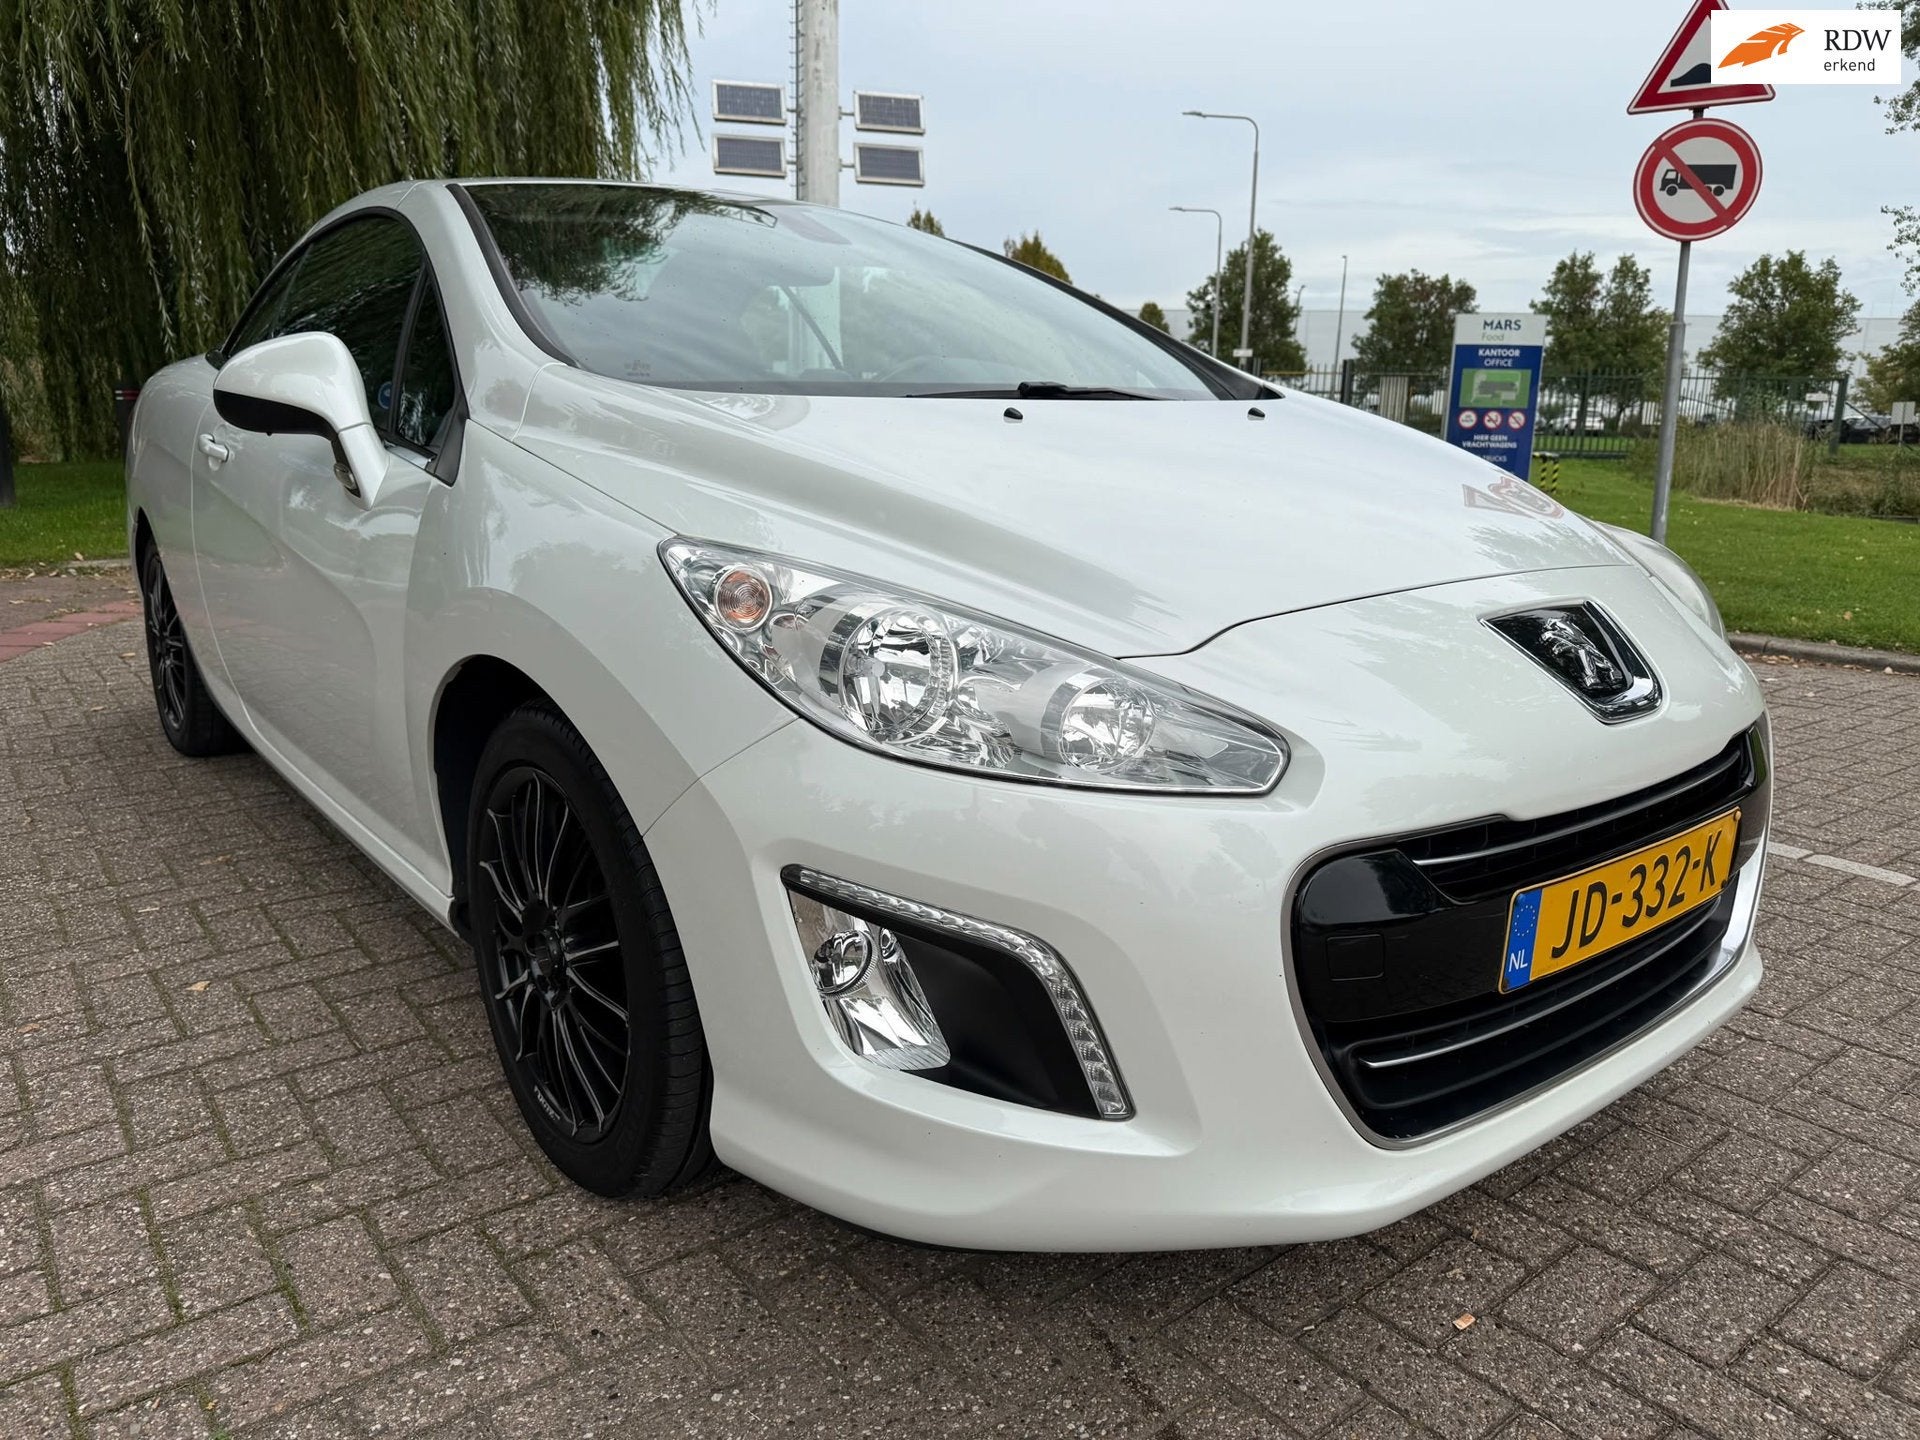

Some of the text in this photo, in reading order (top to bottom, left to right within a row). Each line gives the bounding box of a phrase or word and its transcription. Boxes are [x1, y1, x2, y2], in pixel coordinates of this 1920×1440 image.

[1482, 319, 1522, 331] MARS
[1481, 332, 1505, 342] Food
[1478, 348, 1520, 357] KANTOOR
[1483, 359, 1513, 367] OFFICE
[1462, 441, 1518, 449] VRACHTWAGENS
[1551, 829, 1723, 959] JD-332-K
[1508, 949, 1528, 972] NL
